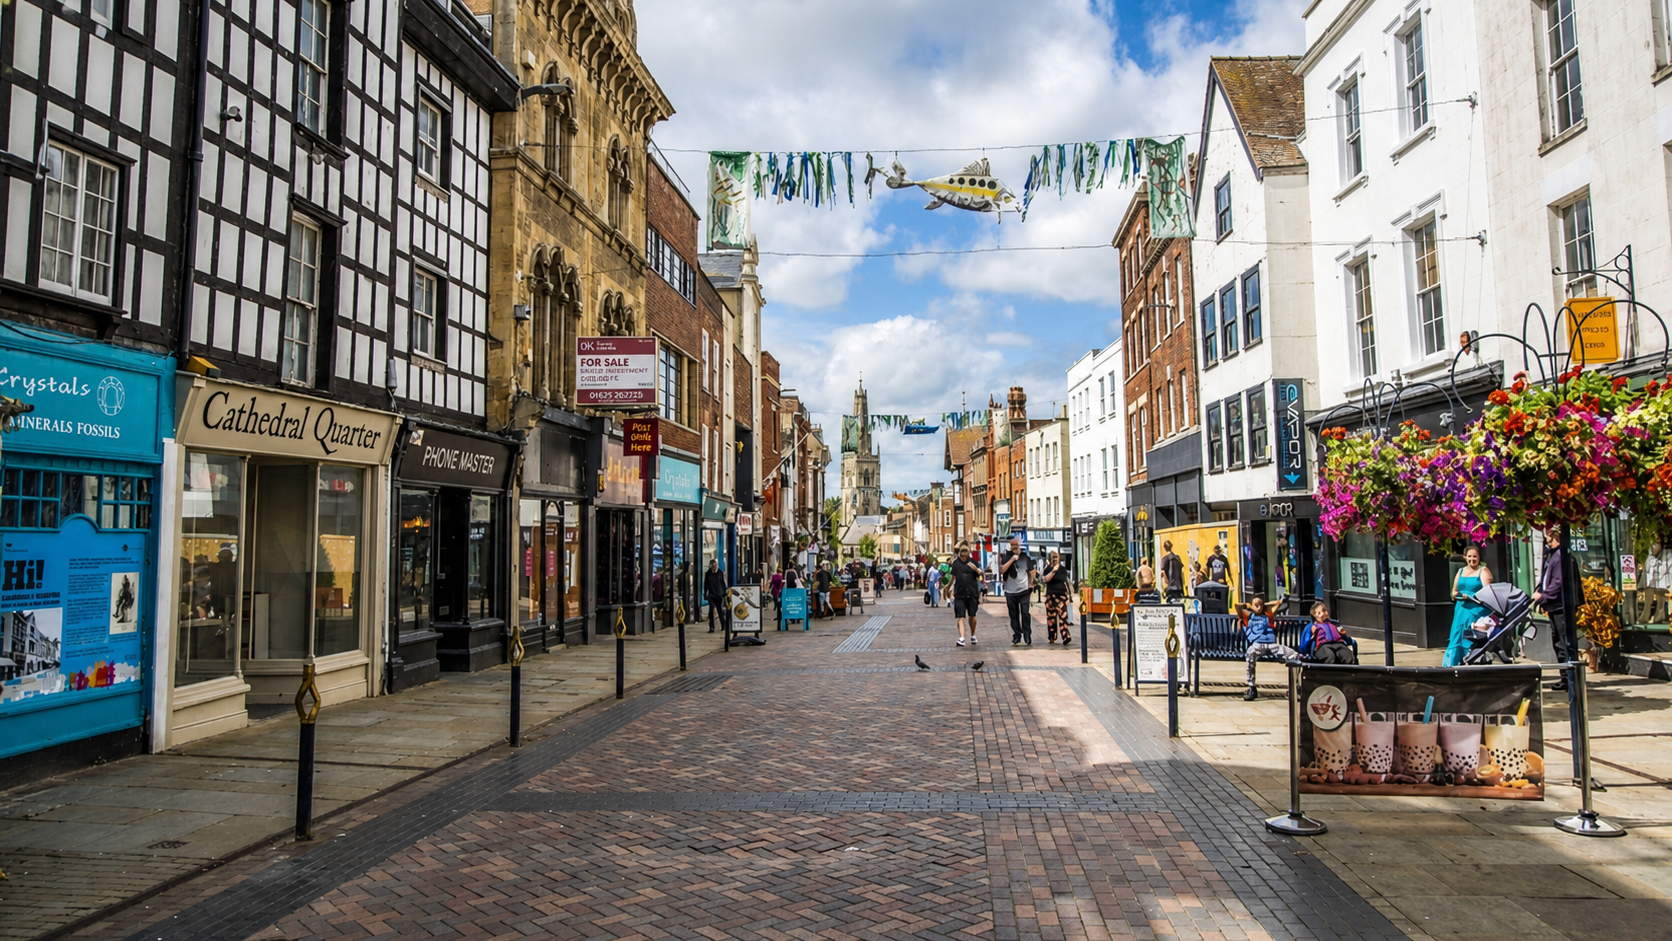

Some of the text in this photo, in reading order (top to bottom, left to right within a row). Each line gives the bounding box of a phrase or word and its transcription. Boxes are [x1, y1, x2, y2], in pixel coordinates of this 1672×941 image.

[580, 341, 595, 351] OK
[580, 358, 629, 367] FOR SALE
[77, 422, 121, 439] FOSSILS
[203, 391, 381, 455] Cathedral Quarter
[422, 445, 495, 474] PHONE MASTER
[2, 559, 45, 591] Hi!
